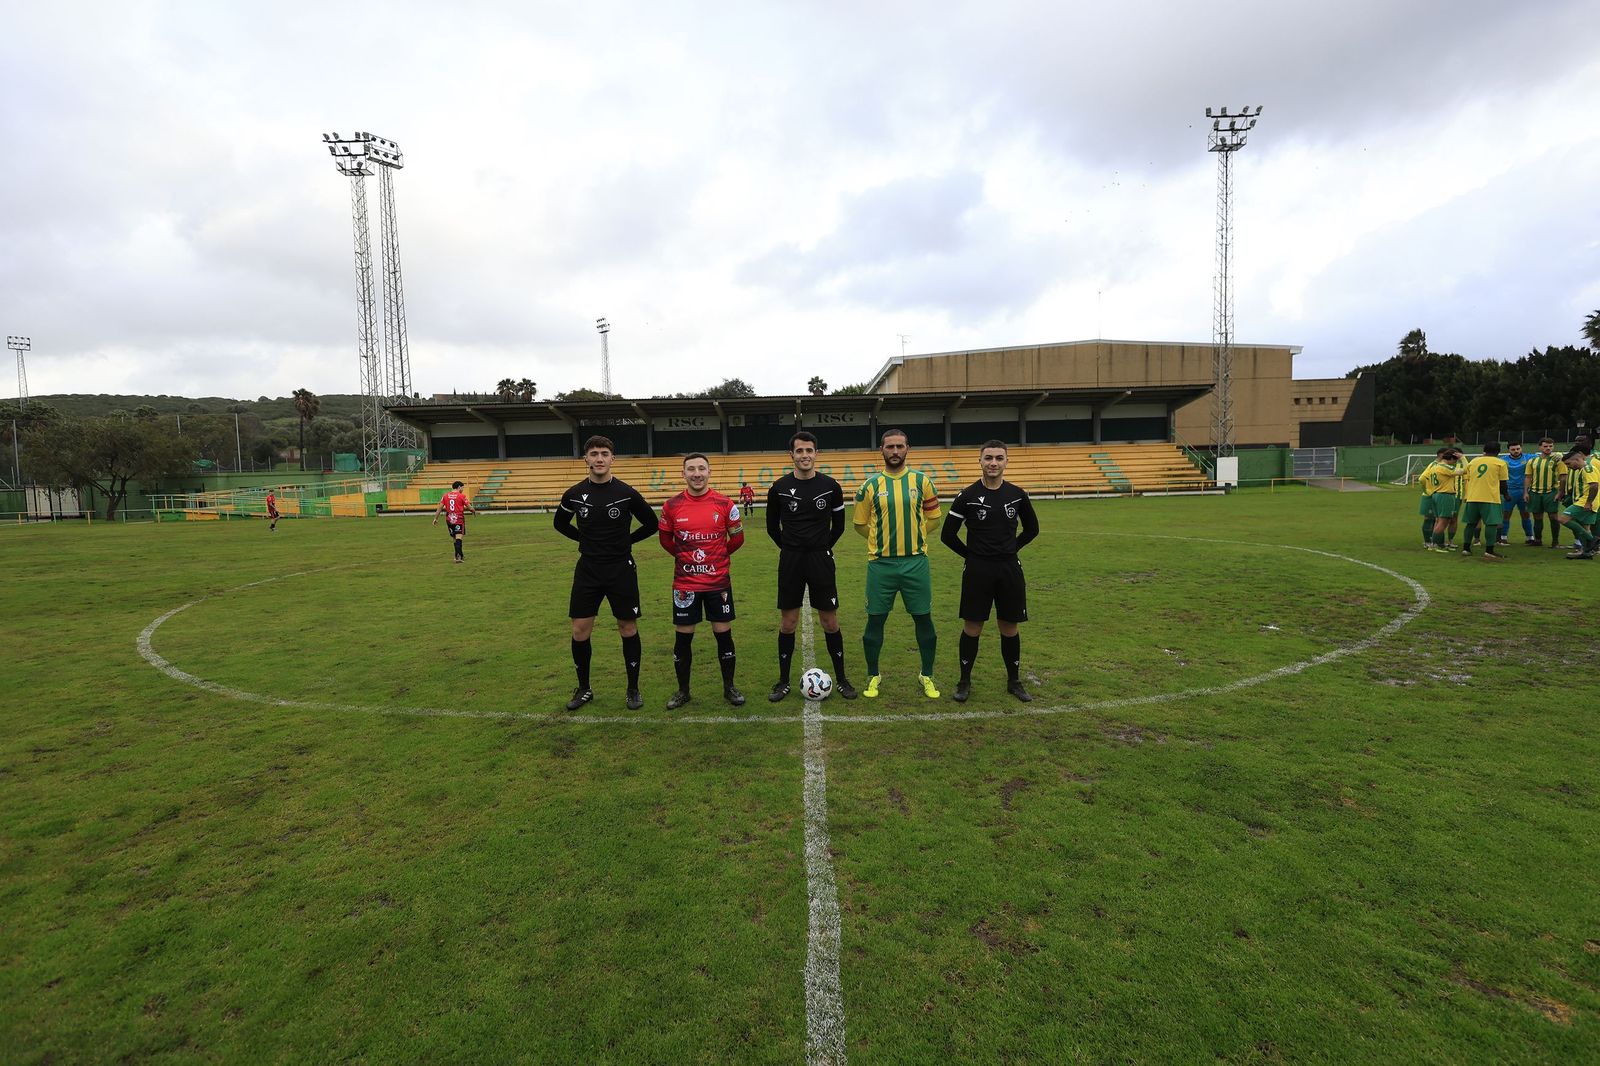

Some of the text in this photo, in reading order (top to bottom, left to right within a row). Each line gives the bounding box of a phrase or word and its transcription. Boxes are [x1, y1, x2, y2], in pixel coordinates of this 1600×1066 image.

[668, 416, 705, 427] RSG
[817, 412, 854, 423] RSG
[1477, 463, 1488, 478] 9
[449, 499, 455, 511] 8
[683, 564, 716, 573] CABRA
[722, 604, 730, 613] 18
